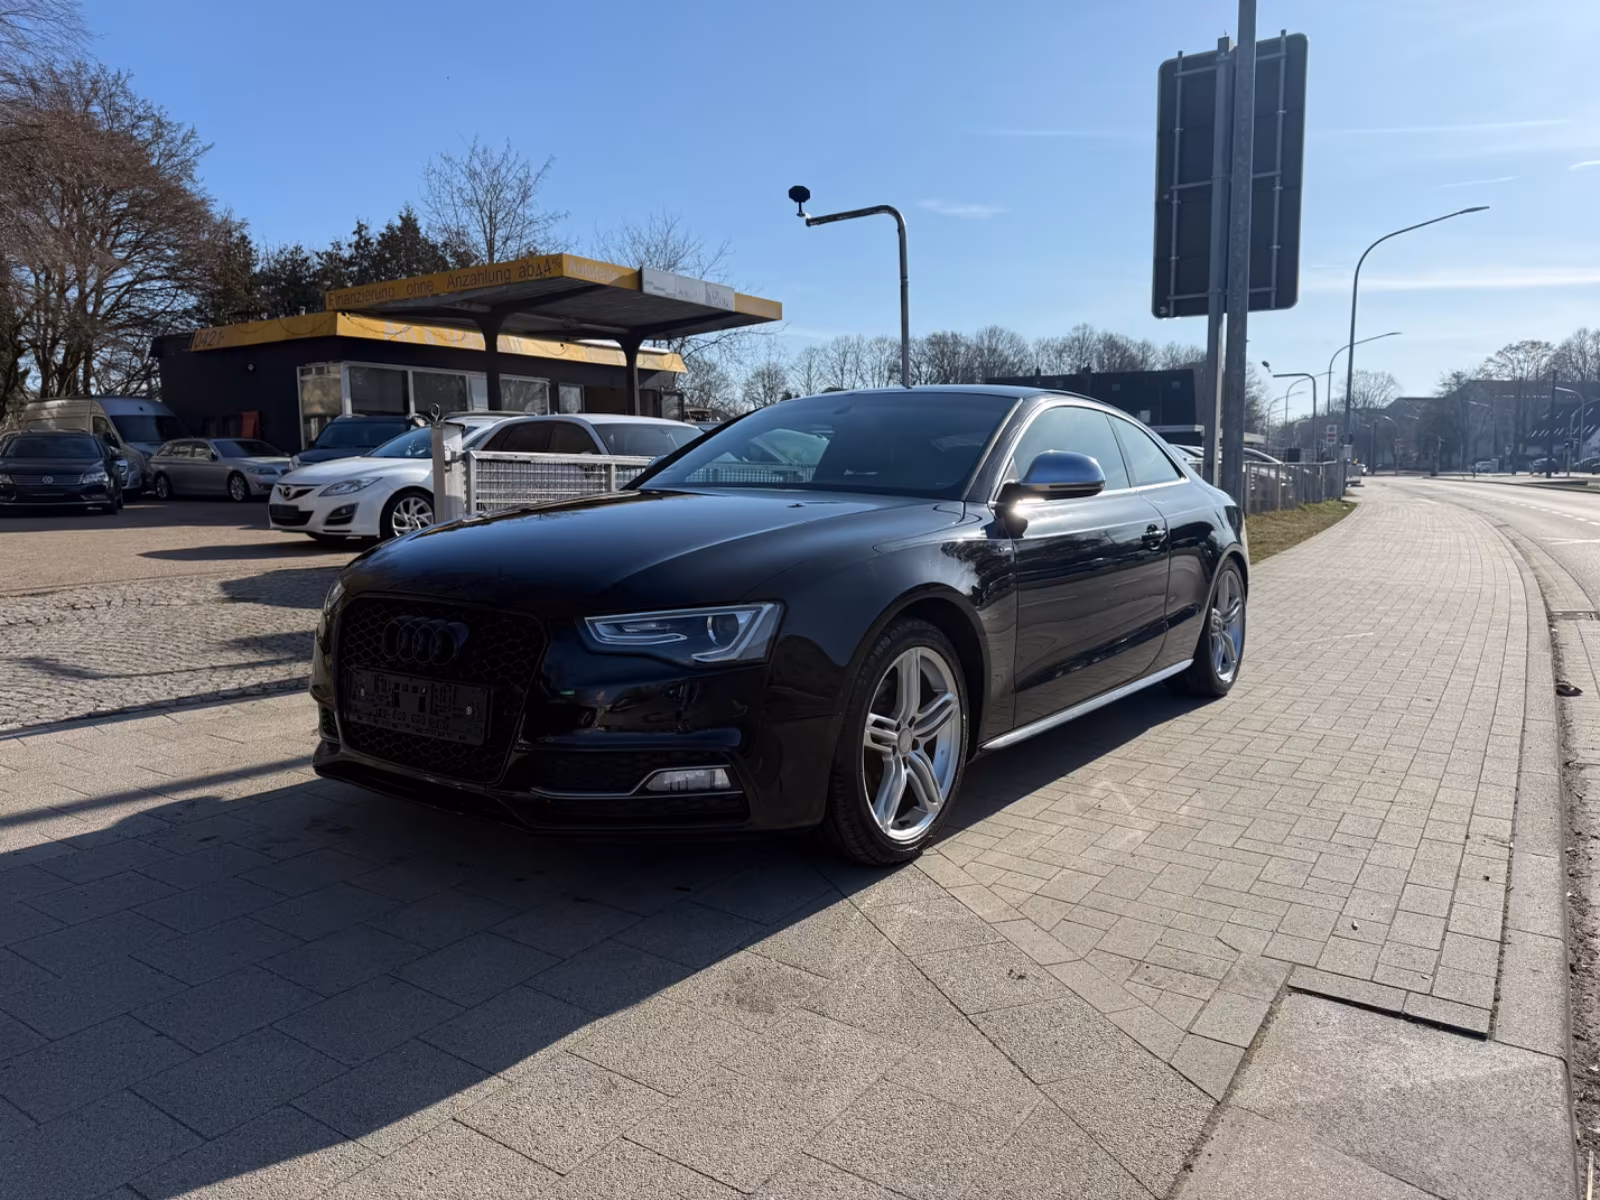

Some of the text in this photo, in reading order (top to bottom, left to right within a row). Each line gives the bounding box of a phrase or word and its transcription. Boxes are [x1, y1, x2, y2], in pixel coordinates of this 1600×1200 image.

[328, 286, 395, 307] Finanzierung
[406, 278, 434, 296] ohne
[446, 267, 511, 290] Anzahlung
